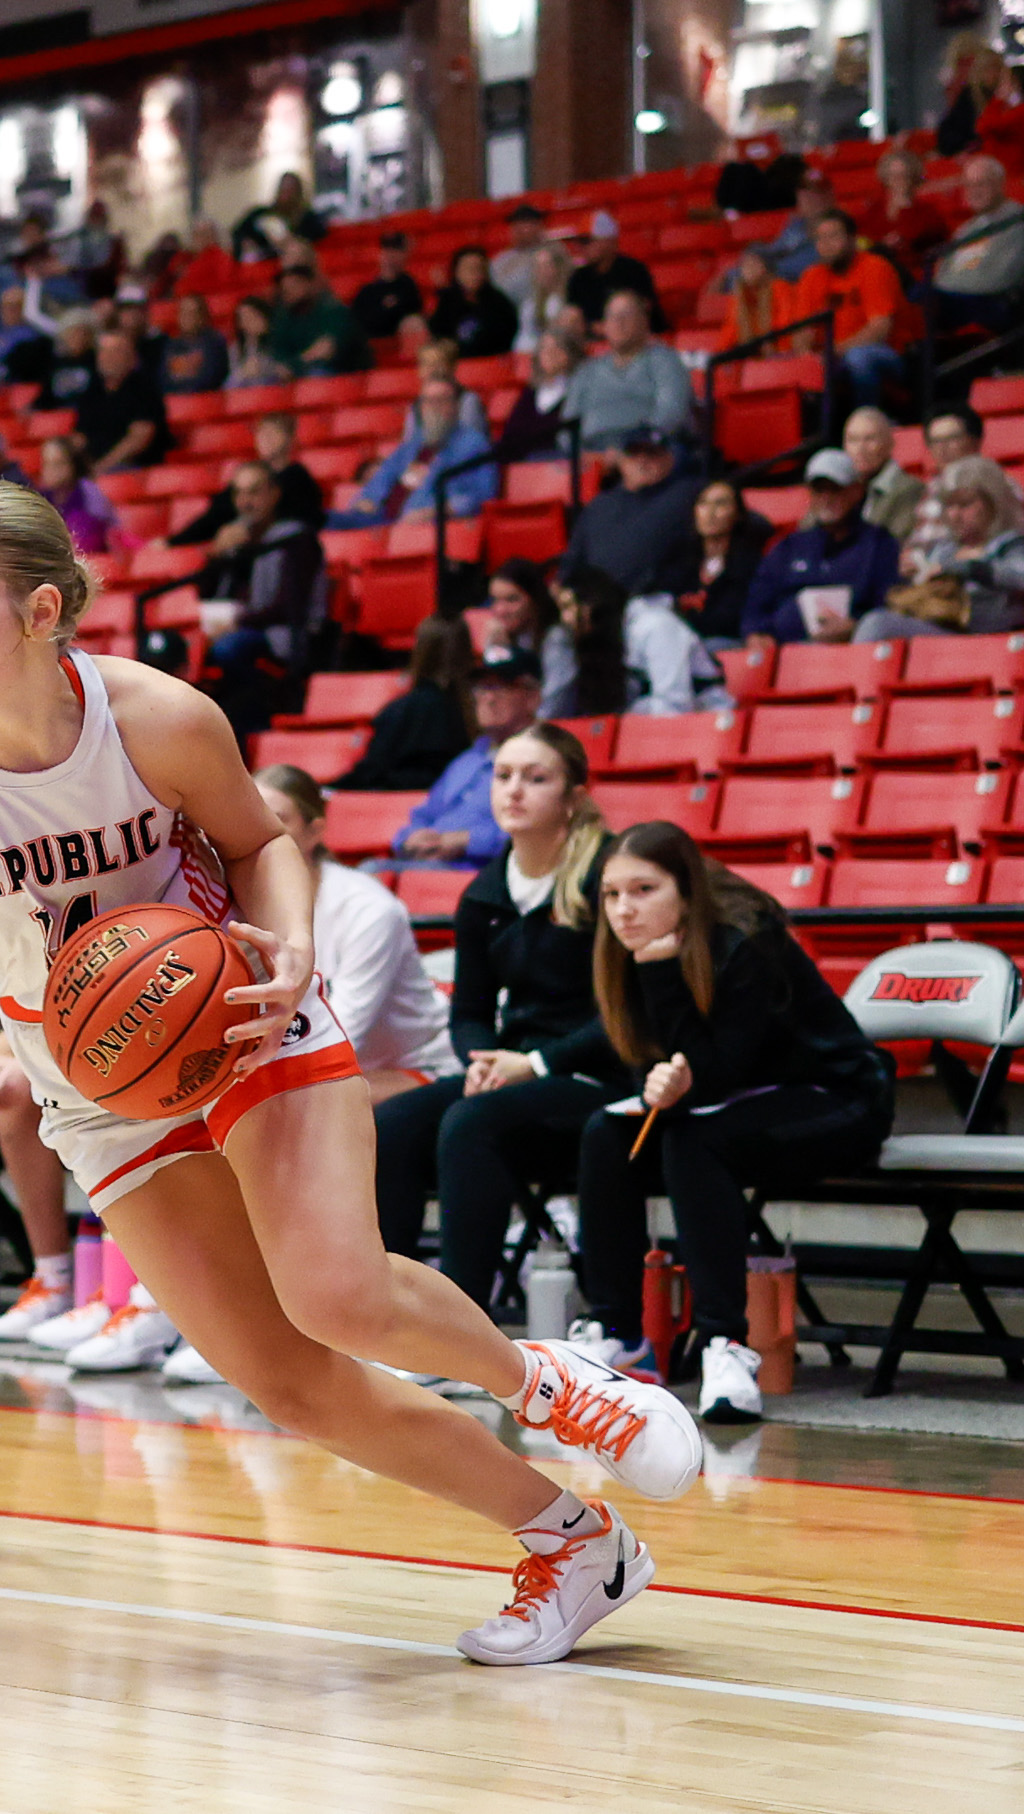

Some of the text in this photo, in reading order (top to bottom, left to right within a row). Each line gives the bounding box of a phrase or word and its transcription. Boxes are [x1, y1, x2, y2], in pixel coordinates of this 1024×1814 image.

[57, 923, 151, 1029] LEGACY
[82, 950, 197, 1078] SPALDING
[869, 973, 984, 1003] DRURY
